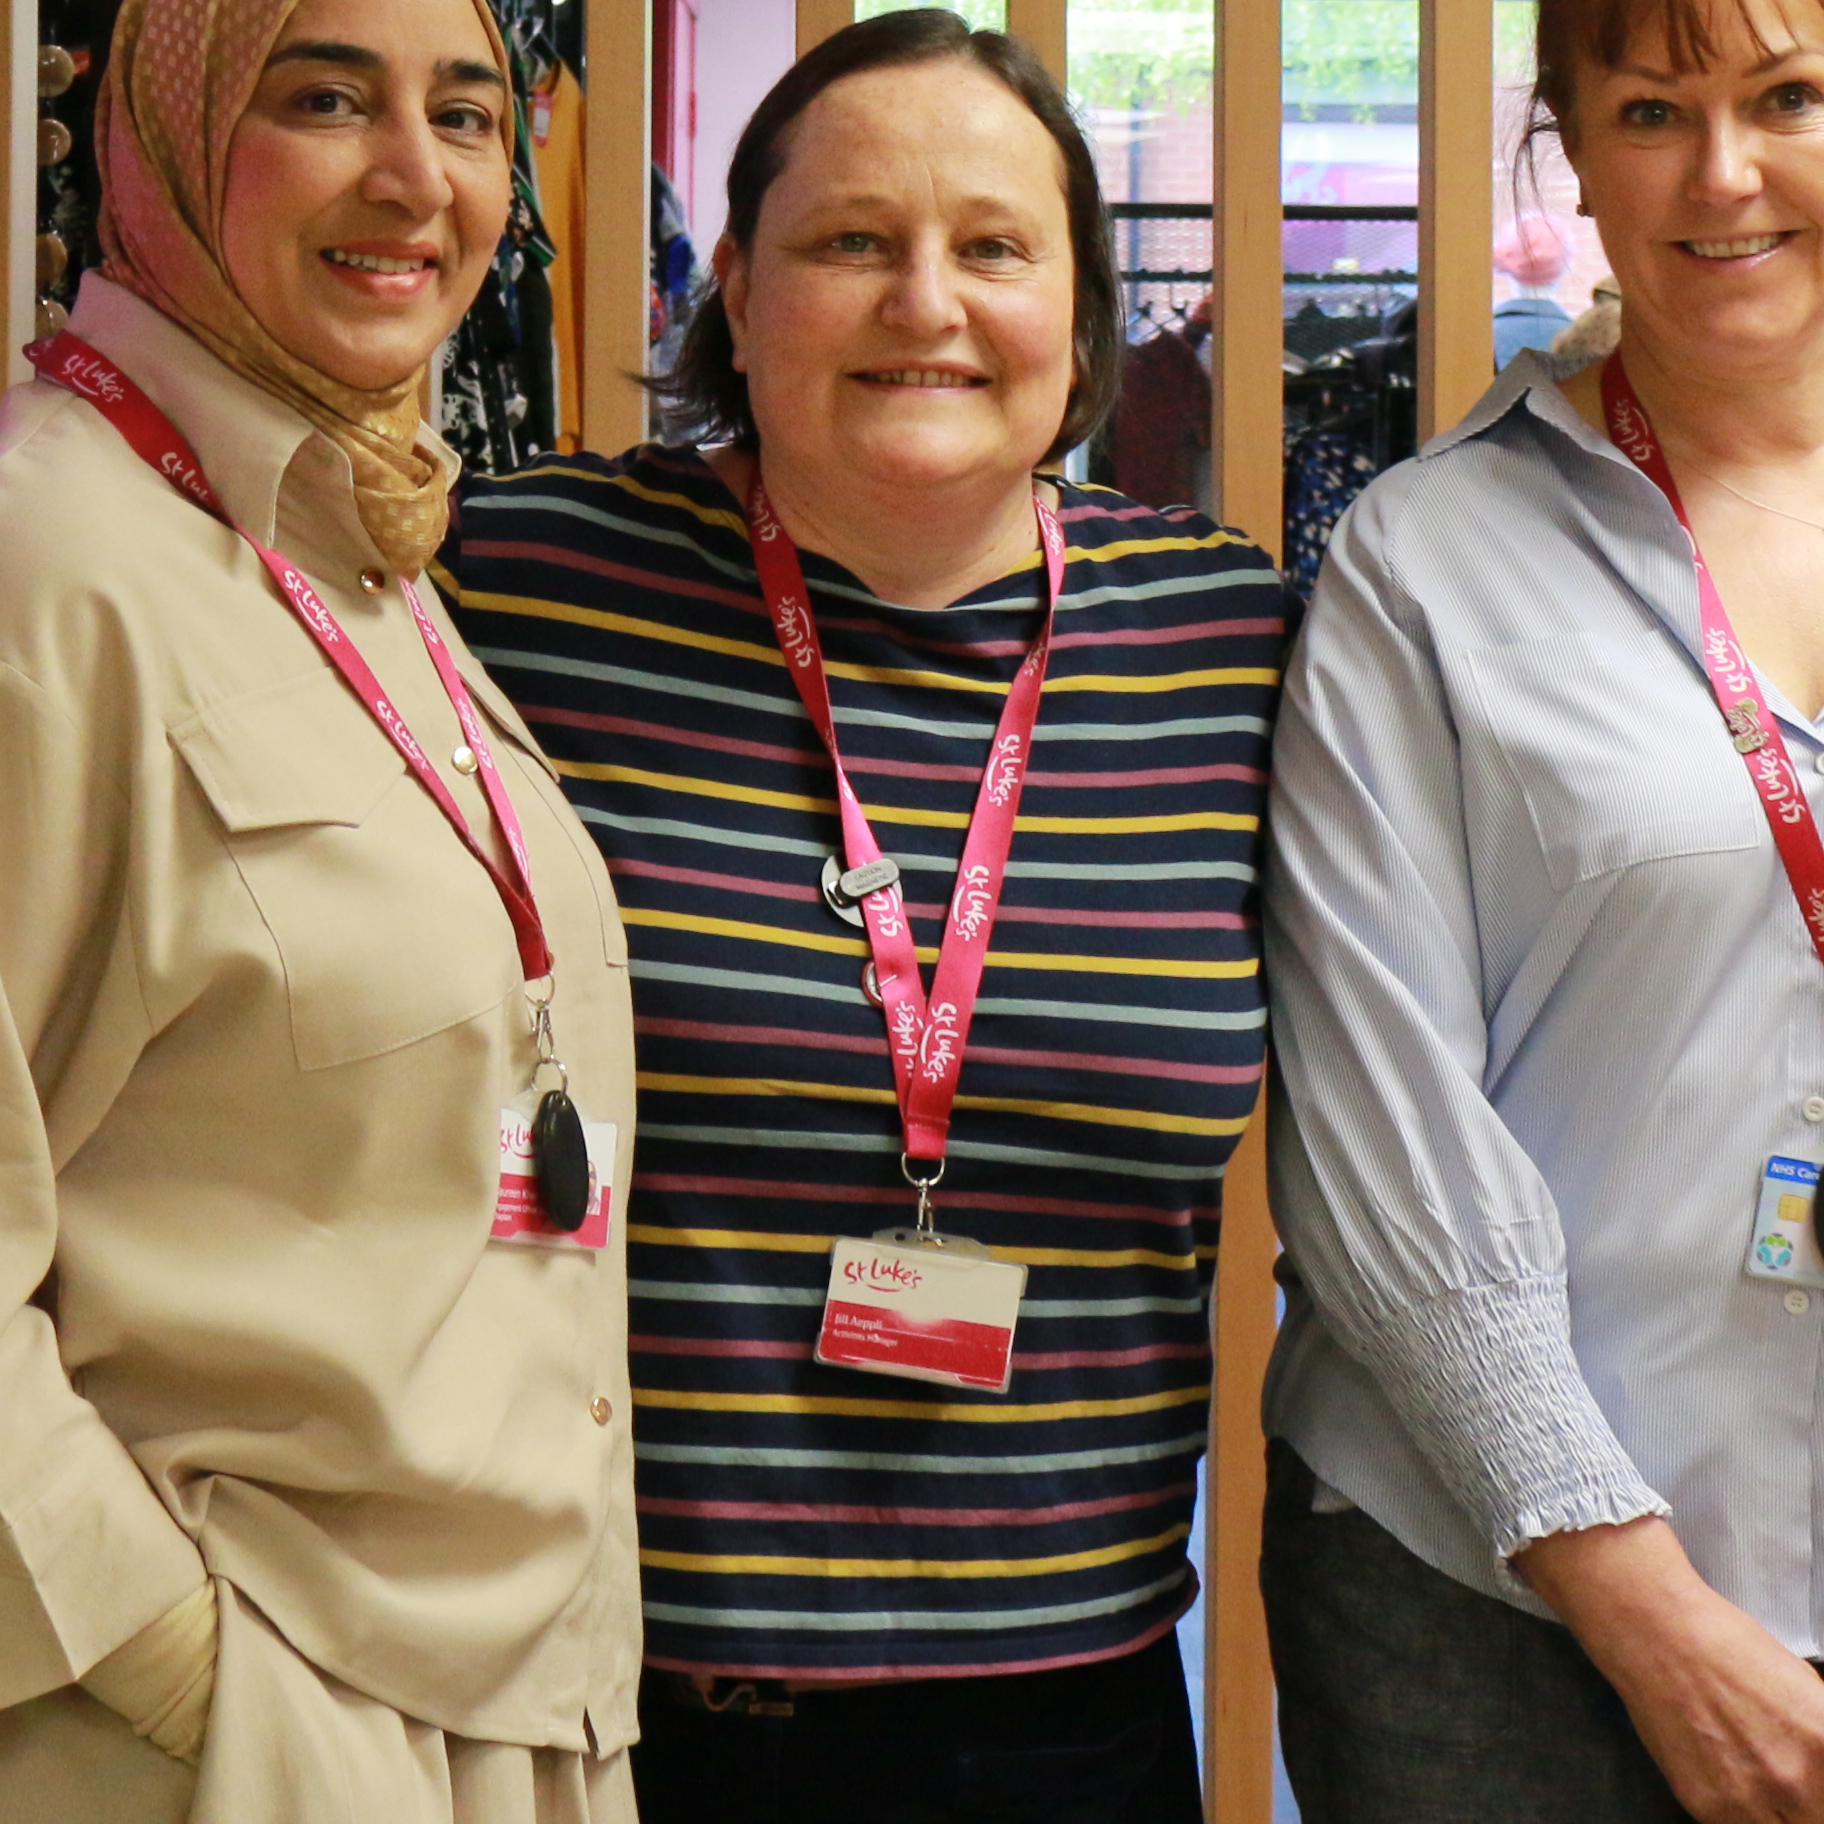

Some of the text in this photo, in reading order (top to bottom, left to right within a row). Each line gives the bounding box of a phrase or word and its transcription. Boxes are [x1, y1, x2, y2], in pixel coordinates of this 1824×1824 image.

[82, 361, 124, 402] Luke's
[1770, 1162, 1796, 1176] NHS
[870, 1258, 923, 1290] Luke's
